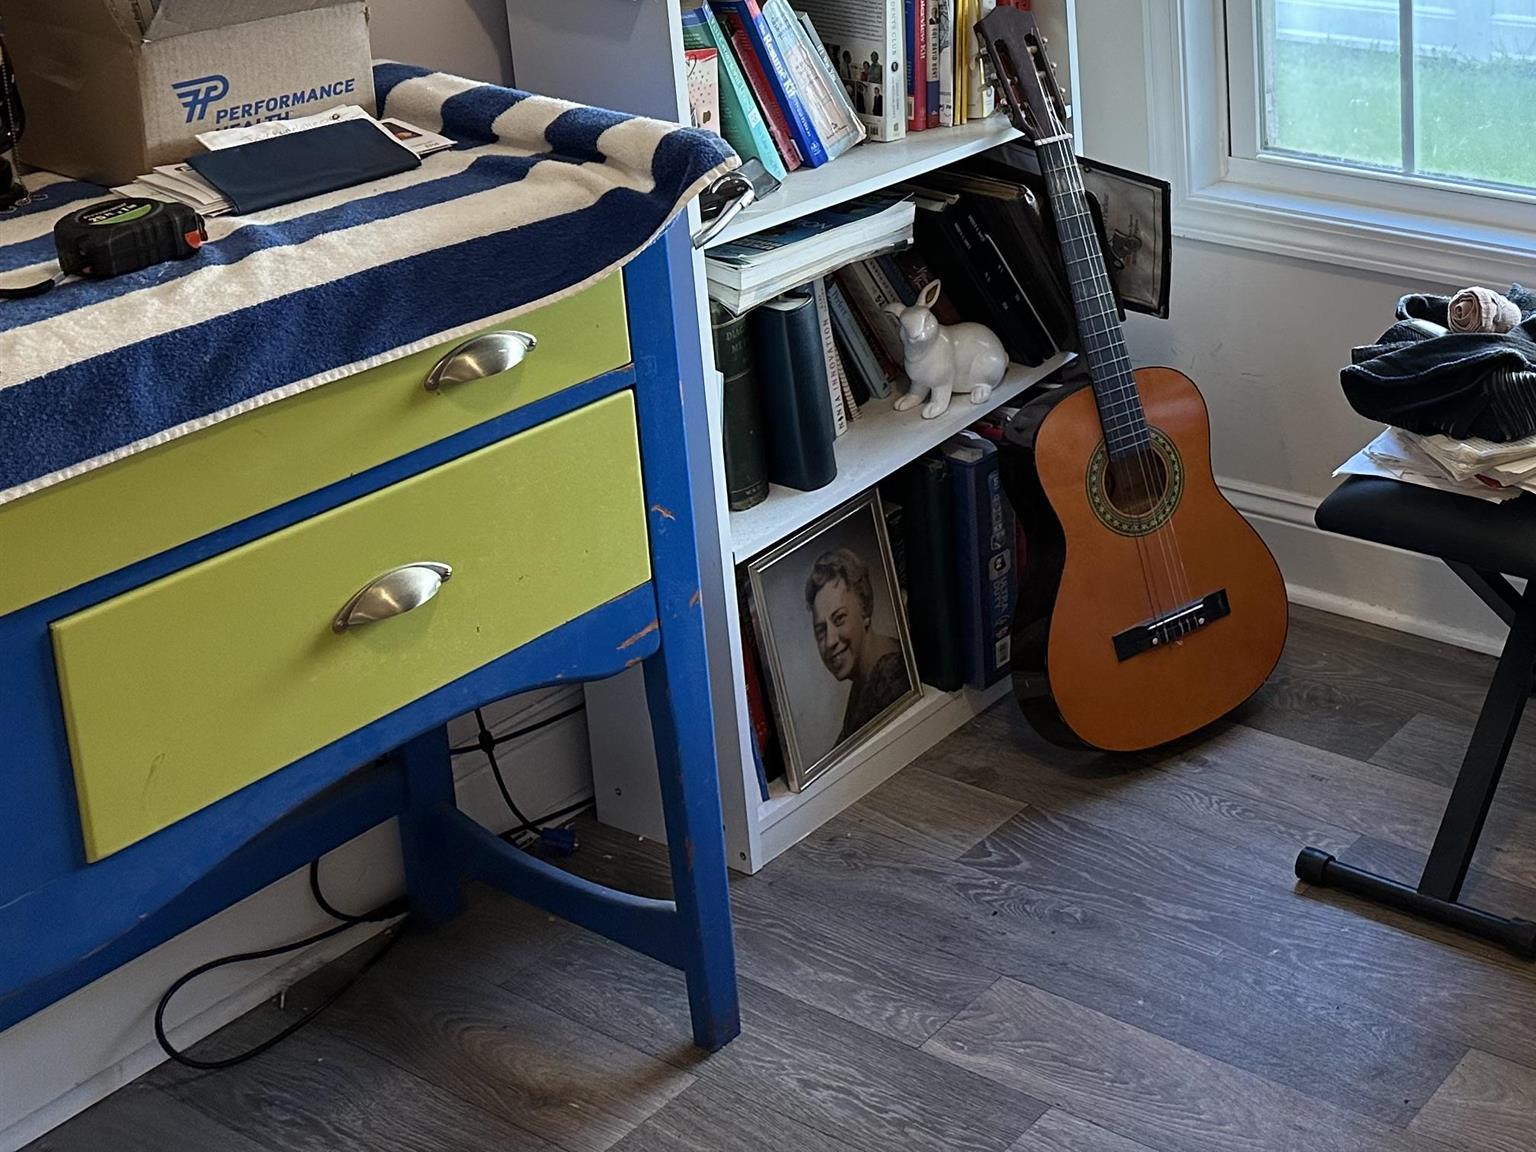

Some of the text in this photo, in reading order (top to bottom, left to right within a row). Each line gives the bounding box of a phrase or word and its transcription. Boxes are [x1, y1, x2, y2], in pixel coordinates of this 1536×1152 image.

[215, 78, 356, 125] PERFORMANCE
[783, 77, 797, 99] Kit
[822, 318, 839, 391] INNOVATION
[834, 394, 845, 430] NINJA
